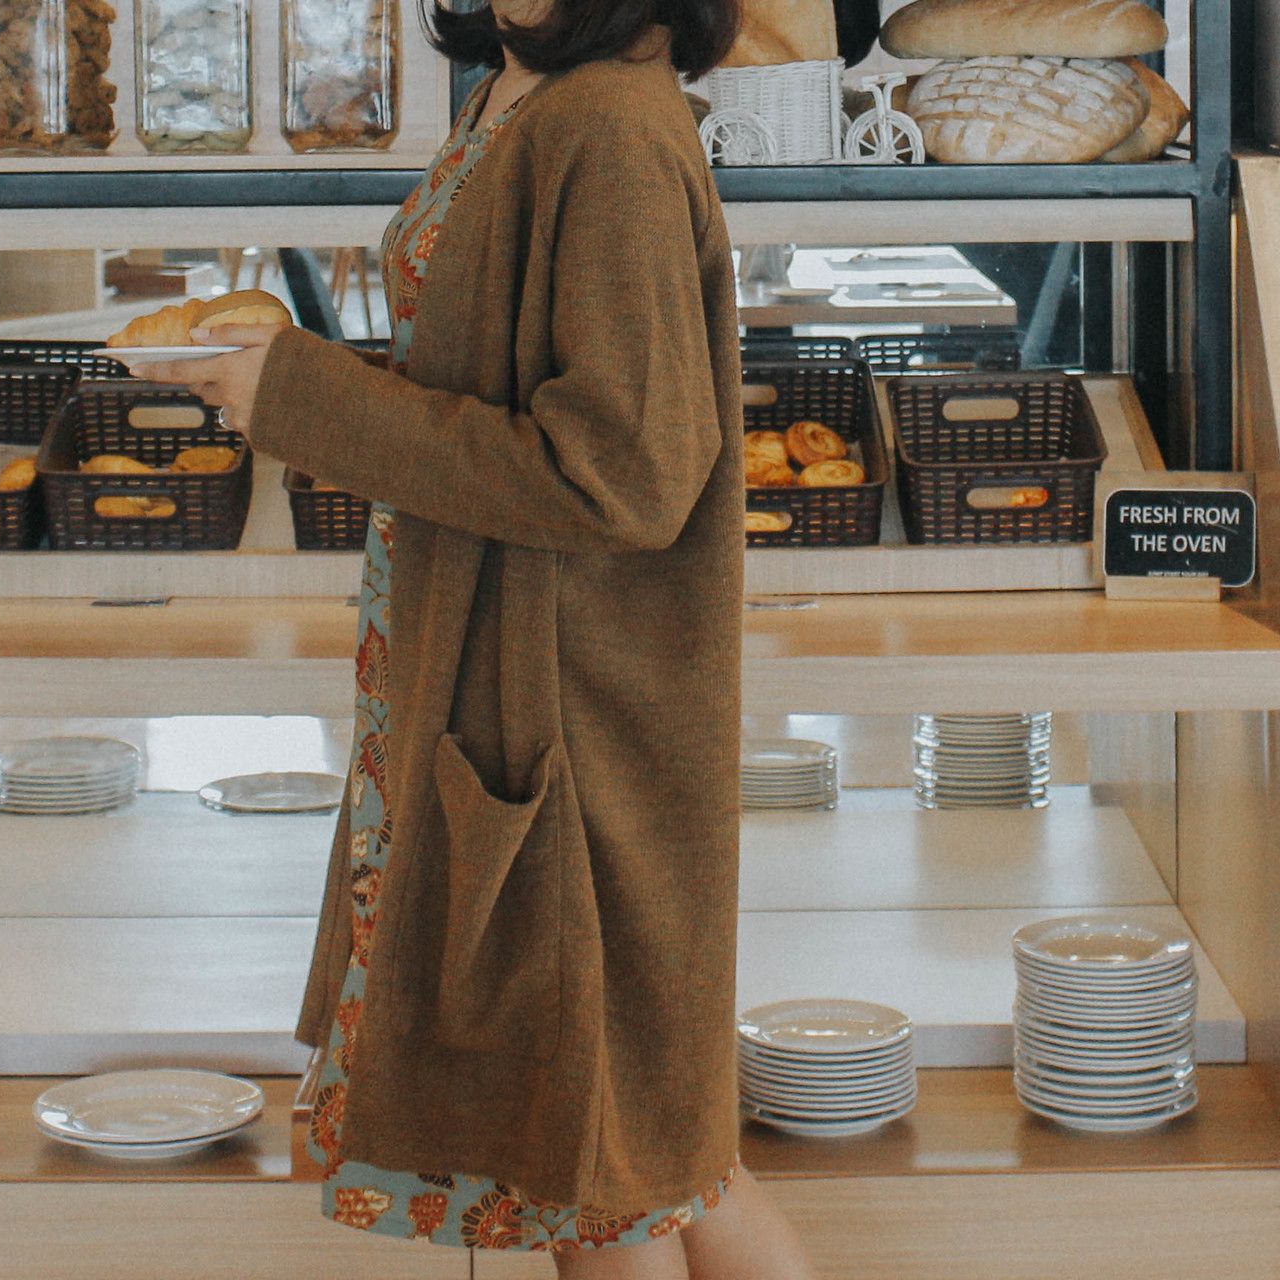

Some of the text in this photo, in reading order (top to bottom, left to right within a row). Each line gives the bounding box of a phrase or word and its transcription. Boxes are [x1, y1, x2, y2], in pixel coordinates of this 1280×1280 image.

[1120, 506, 1240, 525] FRESH FROM
[1131, 534, 1226, 553] THE OVEN
